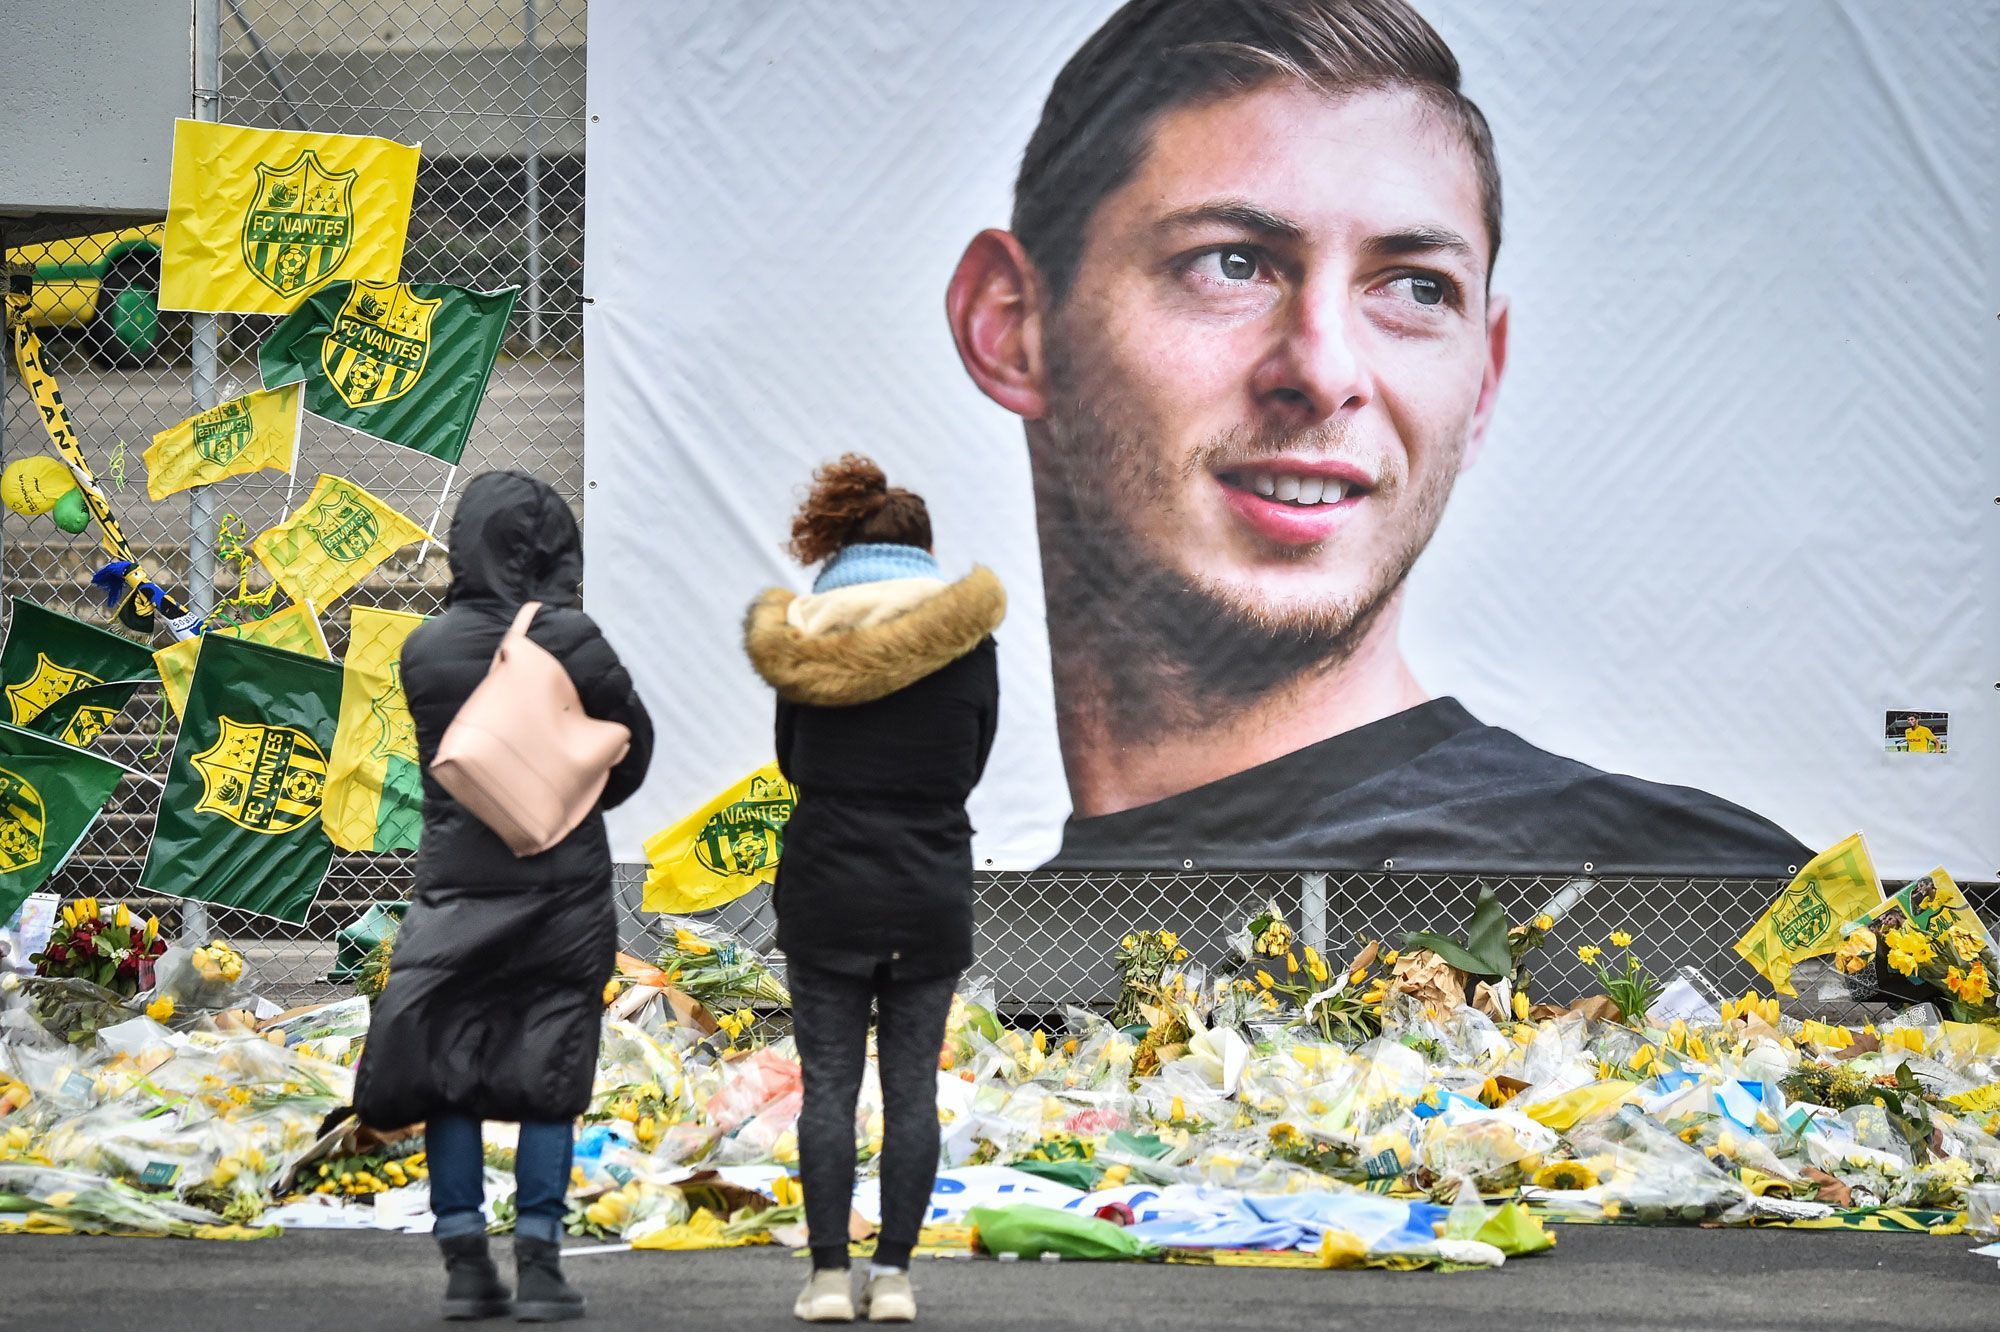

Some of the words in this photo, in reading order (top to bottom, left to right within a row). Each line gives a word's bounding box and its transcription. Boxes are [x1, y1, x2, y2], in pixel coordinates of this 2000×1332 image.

[253, 215, 275, 232] FC
[278, 216, 345, 236] NANTES
[341, 319, 361, 337] FC
[359, 326, 423, 361] NANTES
[251, 731, 284, 799] NANTES
[244, 801, 265, 824] FC
[721, 804, 791, 825] NANTES
